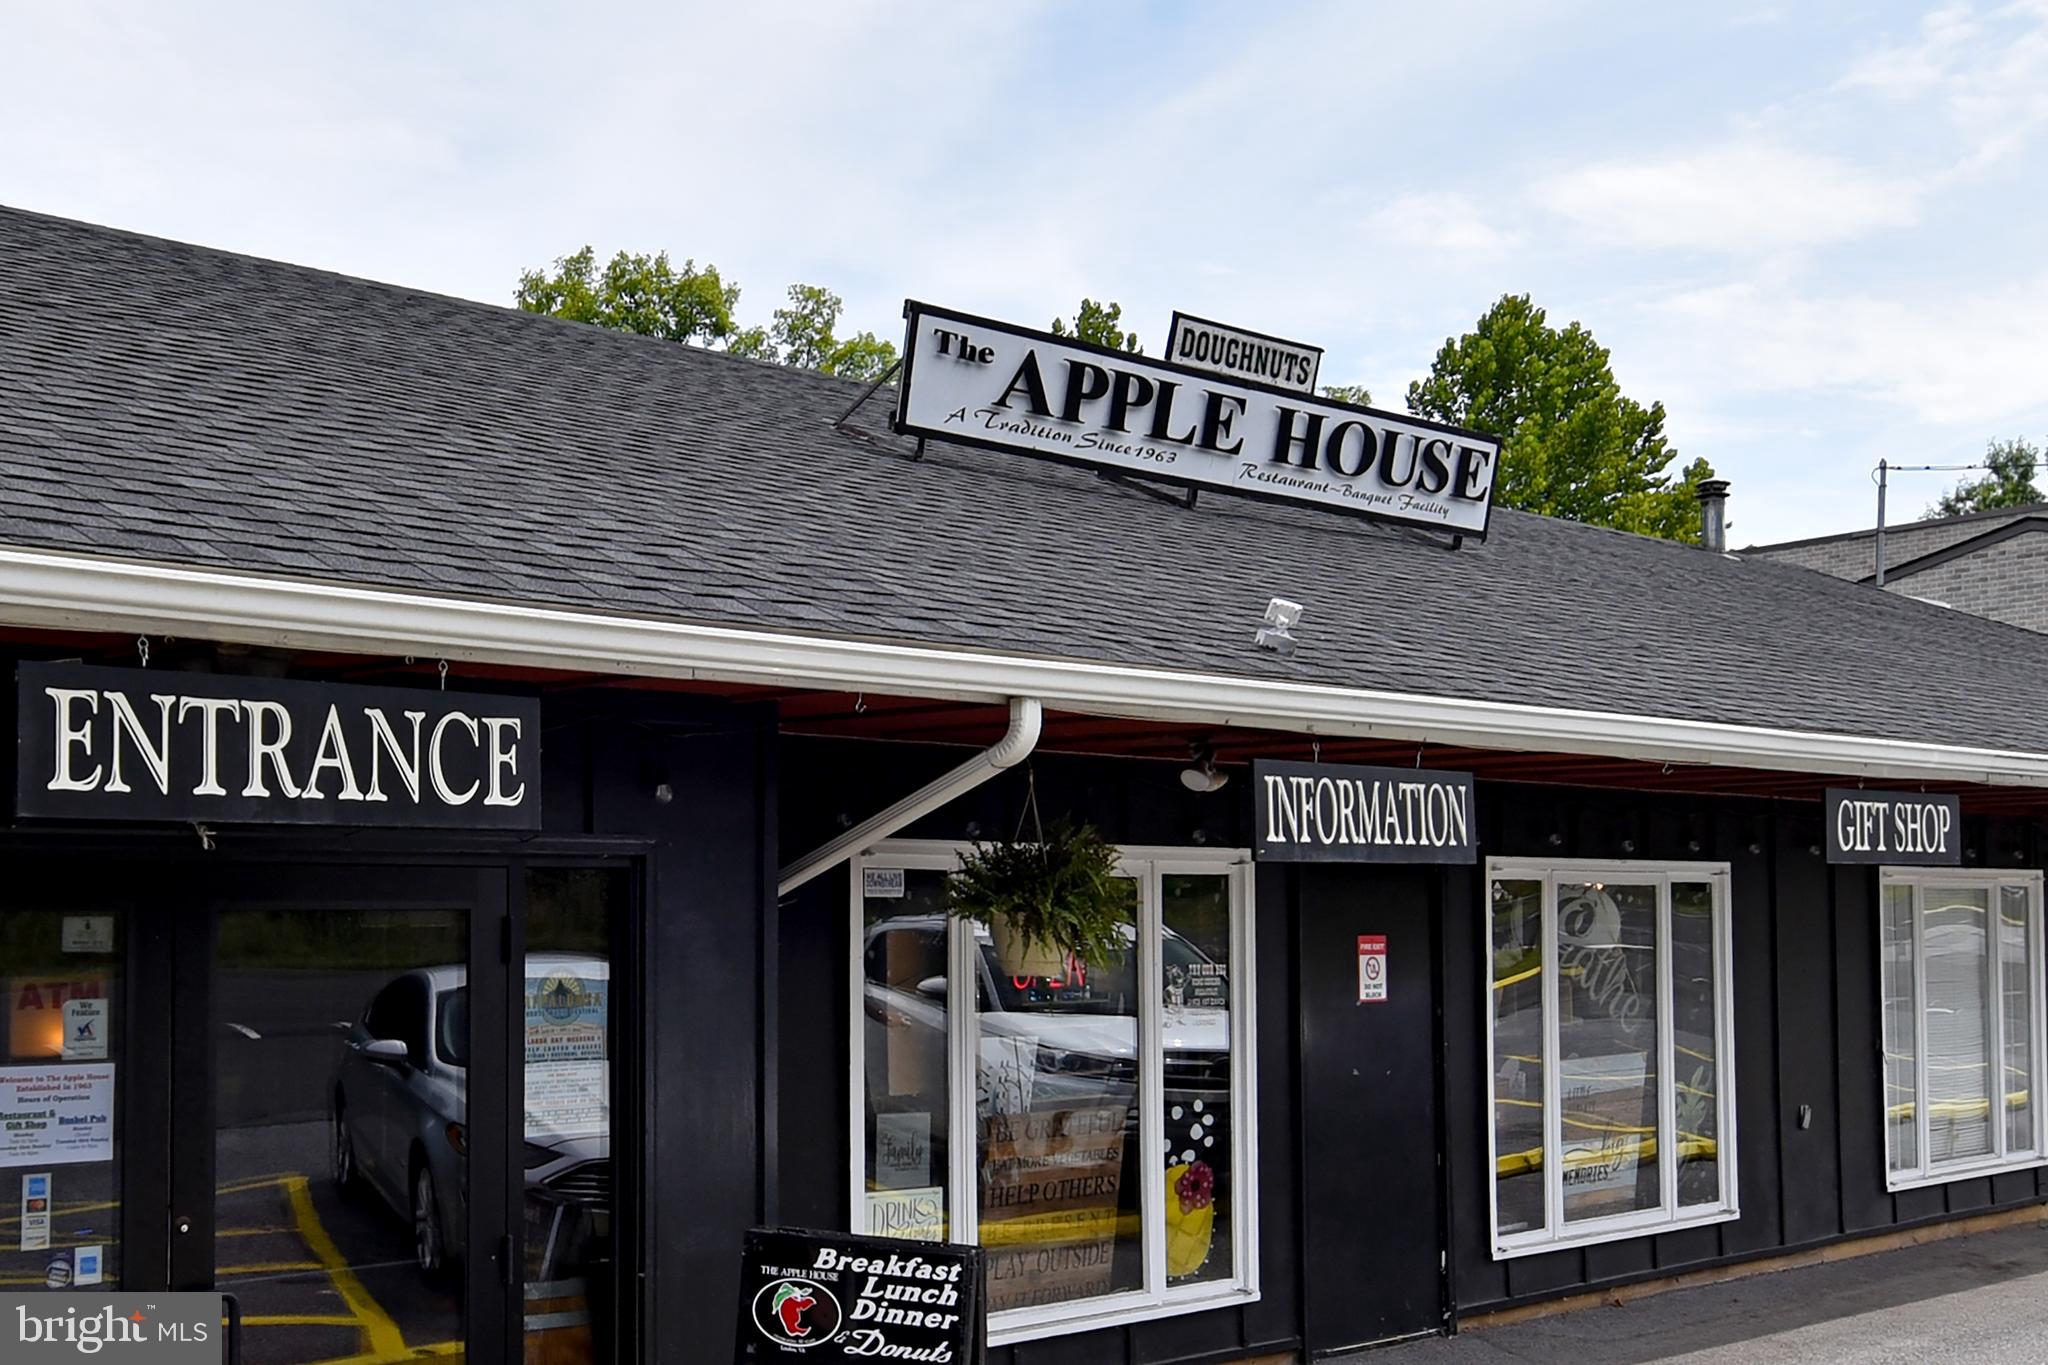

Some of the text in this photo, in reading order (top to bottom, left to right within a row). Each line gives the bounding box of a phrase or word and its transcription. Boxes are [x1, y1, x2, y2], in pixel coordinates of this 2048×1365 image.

[934, 329, 995, 364] The
[1179, 327, 1311, 385] DOUGHNUTS
[944, 407, 965, 427] A
[974, 409, 1073, 443] Tradition
[991, 349, 1491, 502] APPLE HOUSE
[1398, 494, 1450, 518] Facility
[45, 687, 525, 807] ENTRANCE
[1264, 775, 1467, 847] INFORMATION
[1837, 799, 1950, 853] GIFT SHOP
[16, 981, 101, 1009] ATM
[16, 1084, 60, 1092] Established
[63, 1074, 84, 1082] Apple
[52, 1094, 90, 1103] Operation
[5, 1121, 47, 1130] Gift Shop
[993, 1147, 1120, 1173] EAT MORE VEGETABLES
[990, 1175, 1116, 1208] HELP OTHERS
[761, 1265, 839, 1281] THE APPLE HOUSE
[813, 1248, 962, 1282] Breakfast
[986, 1242, 1111, 1281] PLAY OUTSIDE
[861, 1276, 958, 1306] Lunch
[849, 1299, 959, 1329] Dinner
[834, 1331, 850, 1343] &
[844, 1329, 953, 1363] Donuts
